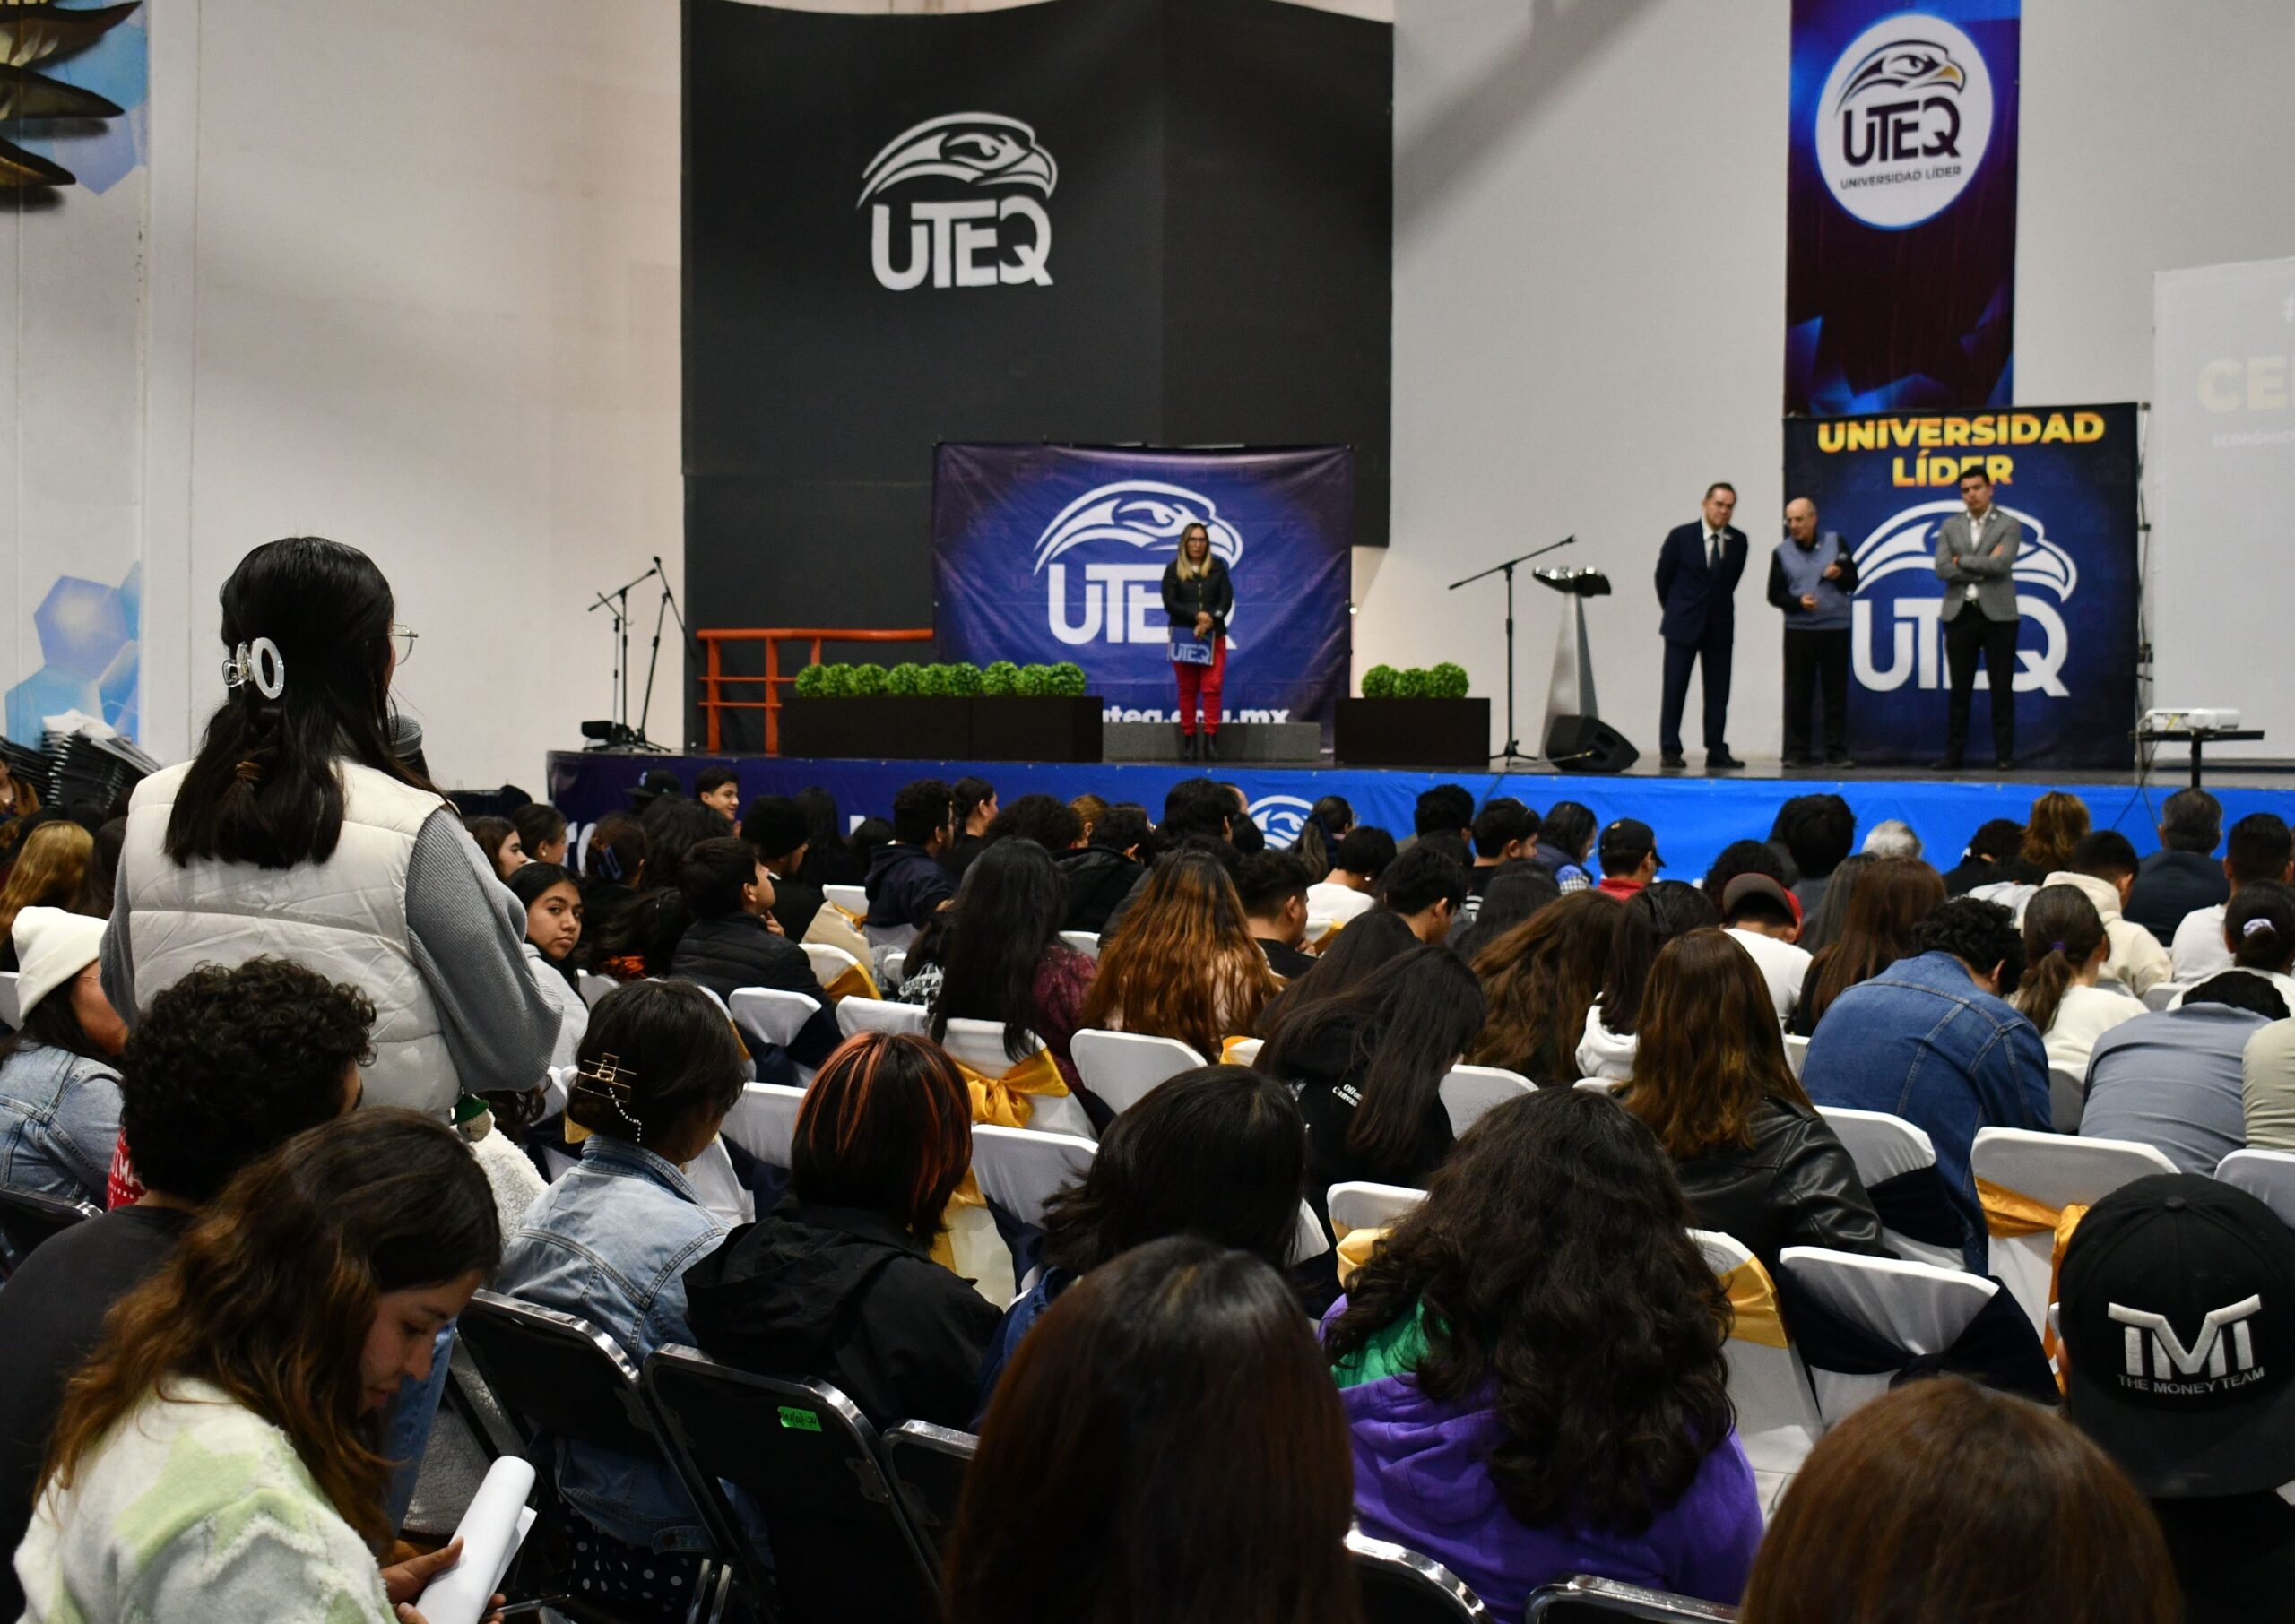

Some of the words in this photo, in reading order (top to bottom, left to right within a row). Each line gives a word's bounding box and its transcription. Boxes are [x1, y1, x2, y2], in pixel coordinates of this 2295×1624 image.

[1842, 96, 1961, 168] UTEQ
[1840, 171, 1921, 189] UNIVERSIDAD
[1926, 167, 1961, 179] LÍDER
[871, 194, 1054, 291] UTEQ
[2197, 357, 2295, 413] CE
[1817, 412, 2106, 453] UNIVERSIDAD
[1170, 643, 1212, 665] UTEQ
[1851, 595, 2071, 697] UTQ
[1332, 1086, 1358, 1108] Canvas
[2117, 1374, 2148, 1390] THE
[2153, 1381, 2217, 1395] MONEY
[2221, 1367, 2265, 1389] TEAM
